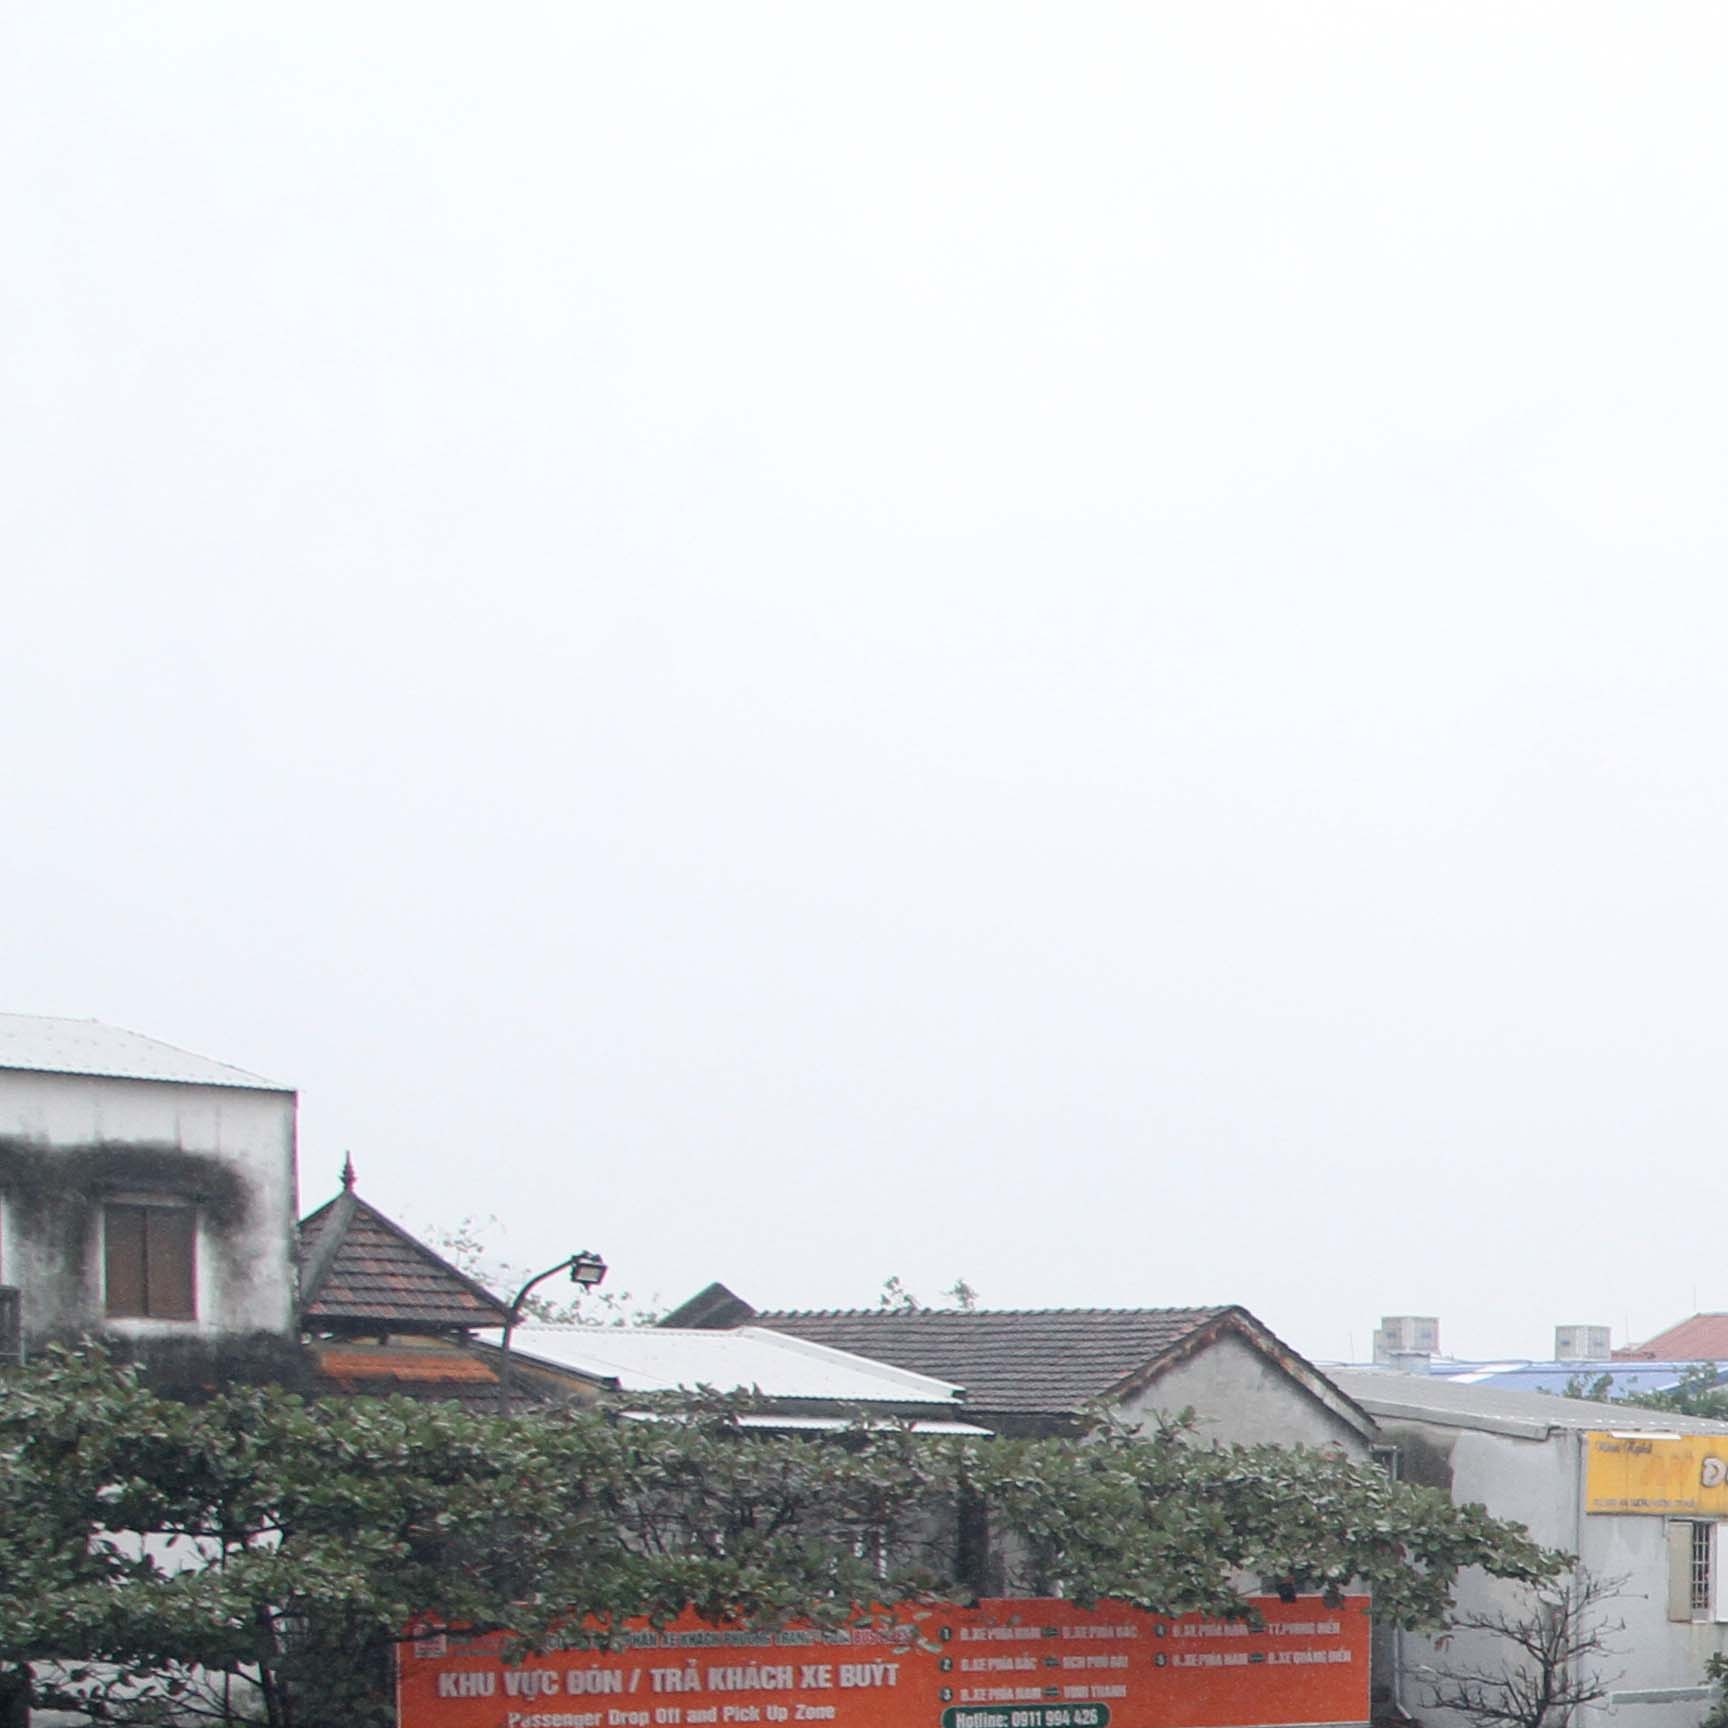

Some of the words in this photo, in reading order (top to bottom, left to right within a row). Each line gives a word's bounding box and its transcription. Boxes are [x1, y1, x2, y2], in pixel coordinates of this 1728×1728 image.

[438, 1672, 496, 1697] KHU
[503, 1669, 560, 1700] VỰC
[650, 1658, 701, 1692] TRẢ
[708, 1661, 793, 1691] KHÁCH
[801, 1665, 832, 1688] XE
[839, 1658, 900, 1688] BUÝT
[508, 1711, 602, 1728] Passenger
[608, 1708, 649, 1727] Drop
[655, 1707, 680, 1724] Off
[687, 1706, 717, 1723] and
[723, 1705, 760, 1722] Pick
[767, 1705, 788, 1722] Up
[795, 1705, 835, 1720] Zone
[955, 1712, 1008, 1728] Hotline:
[1011, 1711, 1041, 1728] 0911
